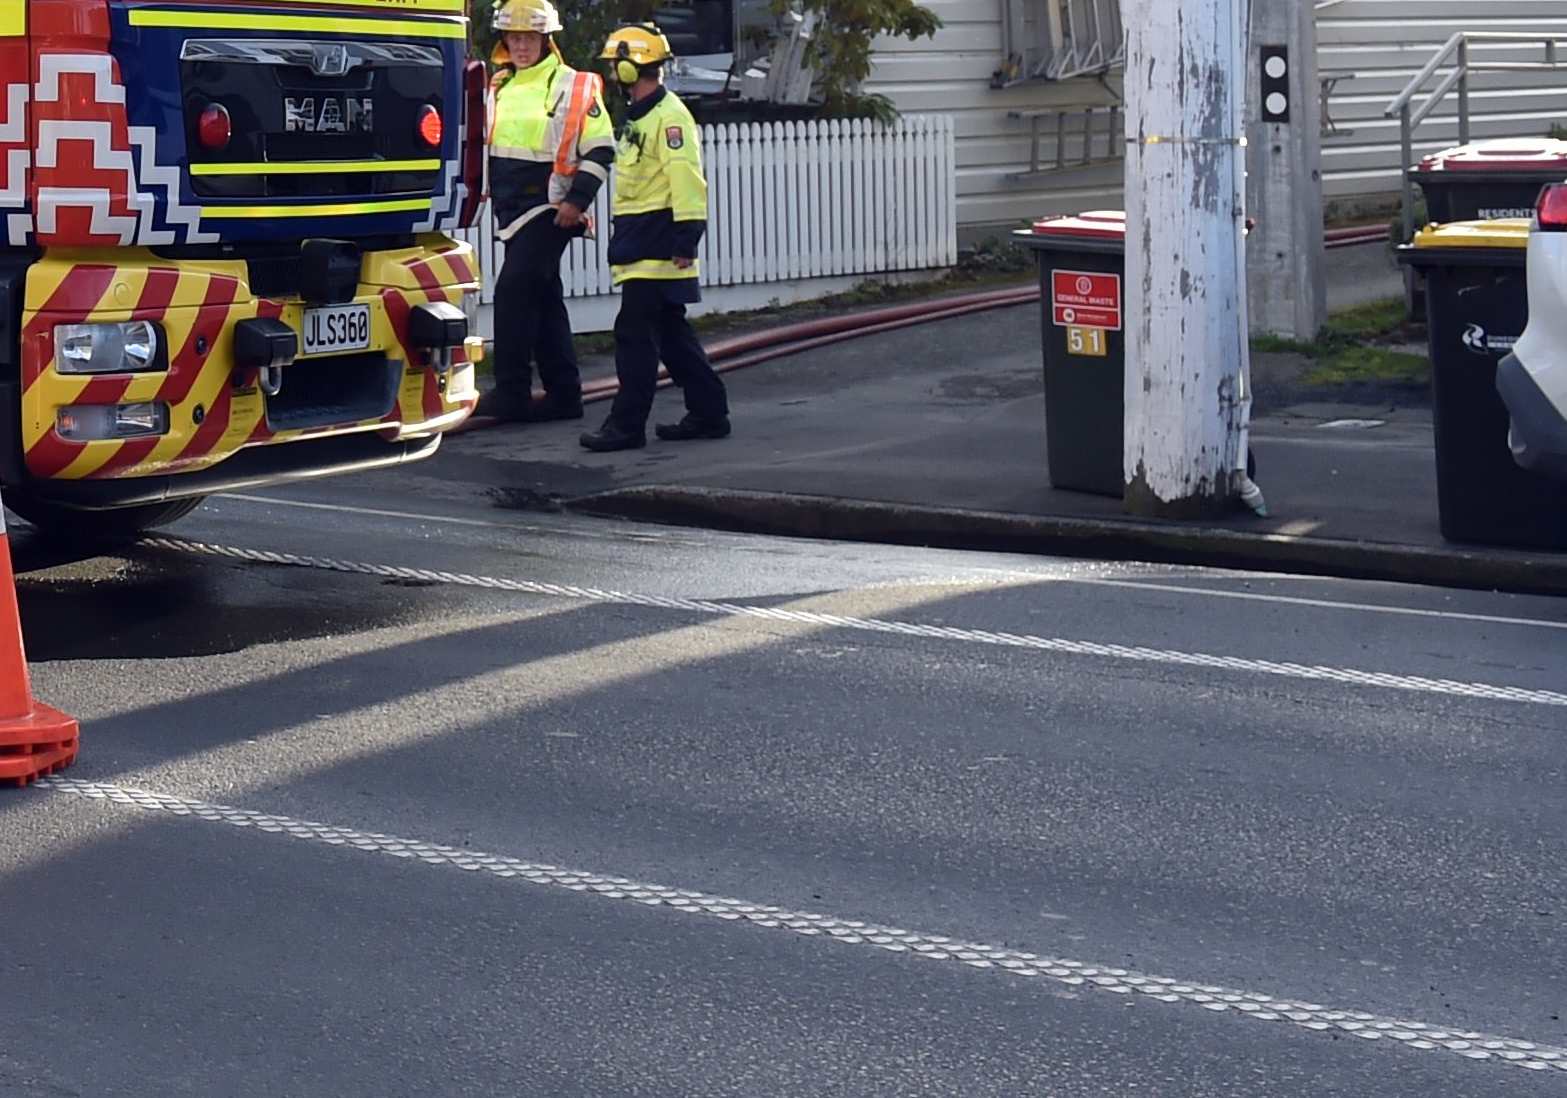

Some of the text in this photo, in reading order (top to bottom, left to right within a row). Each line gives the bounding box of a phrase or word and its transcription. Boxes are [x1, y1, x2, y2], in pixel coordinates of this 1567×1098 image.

[284, 98, 374, 132] MAN
[1057, 293, 1115, 306] GENERAL WASTE
[306, 311, 368, 347] JLS360
